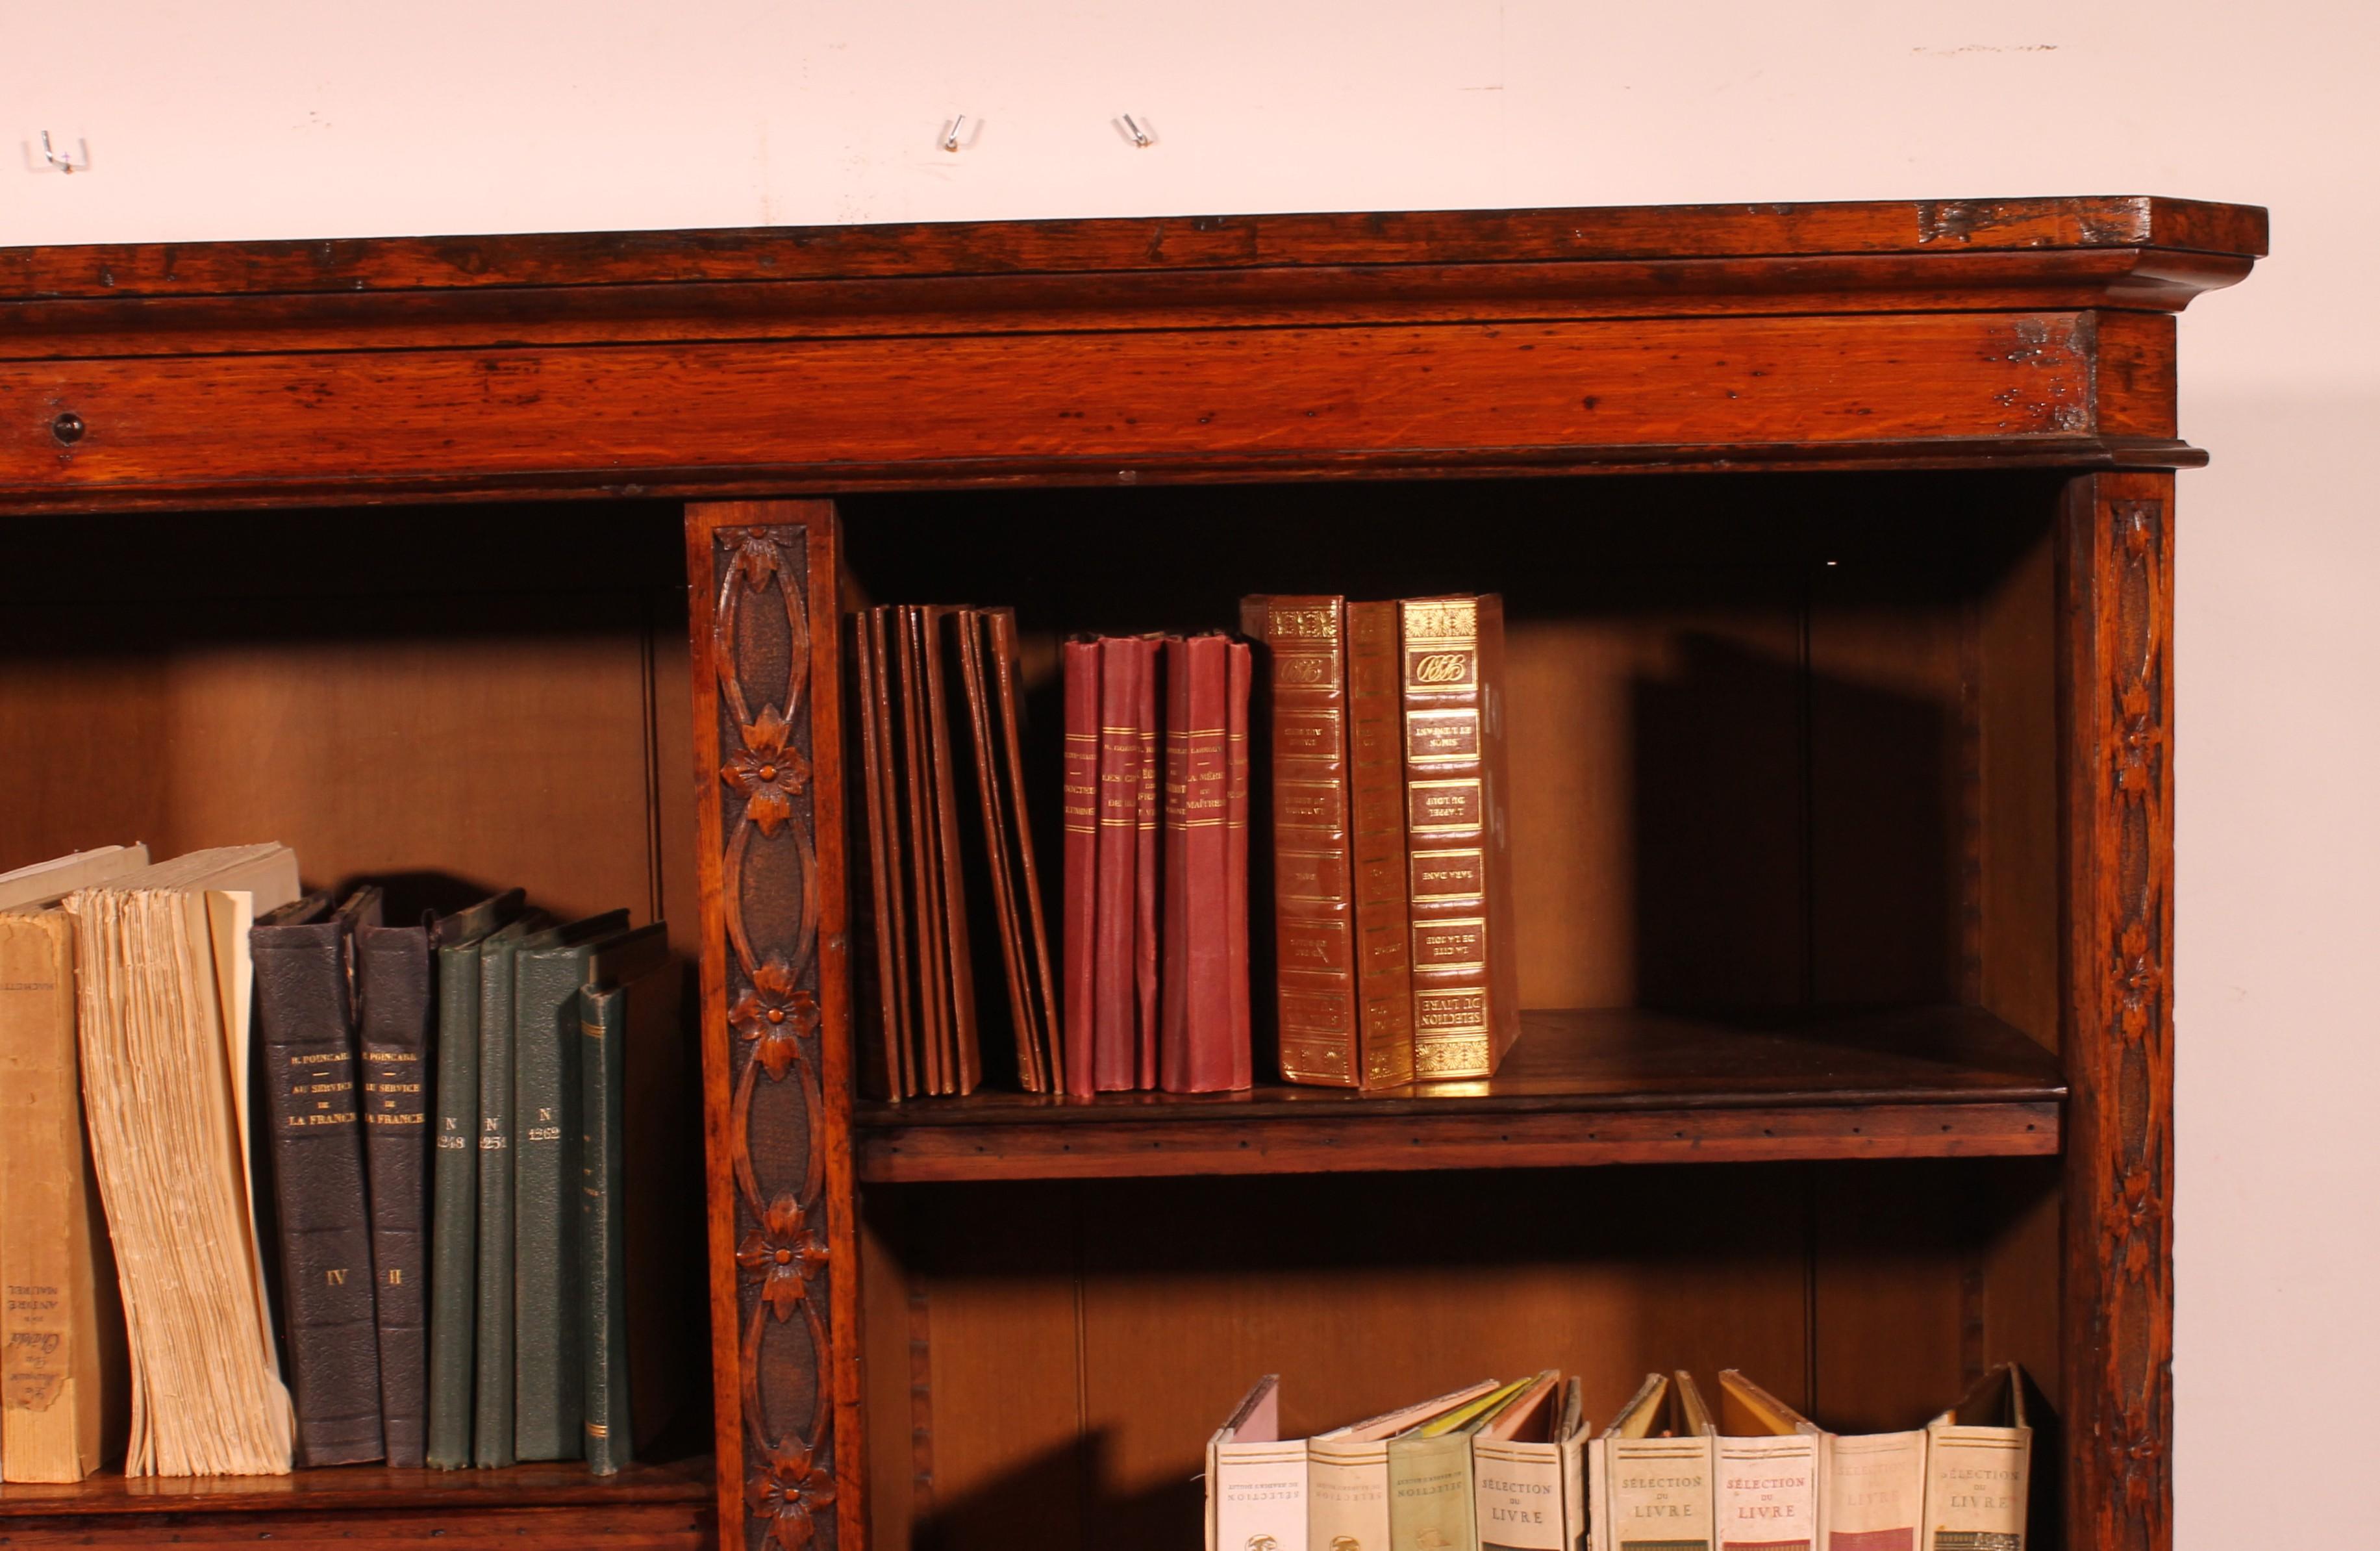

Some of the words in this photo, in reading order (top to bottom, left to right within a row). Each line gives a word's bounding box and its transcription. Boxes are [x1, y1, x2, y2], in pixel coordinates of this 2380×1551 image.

[1422, 998, 1460, 1011] LIVRE
[1463, 997, 1482, 1009] DU
[379, 1083, 421, 1092] SERVICE
[288, 1116, 307, 1126] LA
[377, 1113, 425, 1124] FRANCE
[538, 1107, 552, 1122] N
[442, 1116, 458, 1131] N
[484, 1117, 500, 1131] N
[325, 1268, 349, 1286] IV
[388, 1268, 403, 1285] II
[1940, 1468, 2020, 1480] SÉLECTION
[1481, 1479, 1552, 1494] SÉLECTION
[1622, 1476, 1702, 1489] SÉLECTION
[1726, 1477, 1805, 1489] SÉLECTION
[1950, 1495, 2009, 1509] LIVRE
[1492, 1507, 1544, 1524] LIVRE
[1635, 1504, 1693, 1518] LIVRE
[1738, 1505, 1796, 1519] LIVRE
